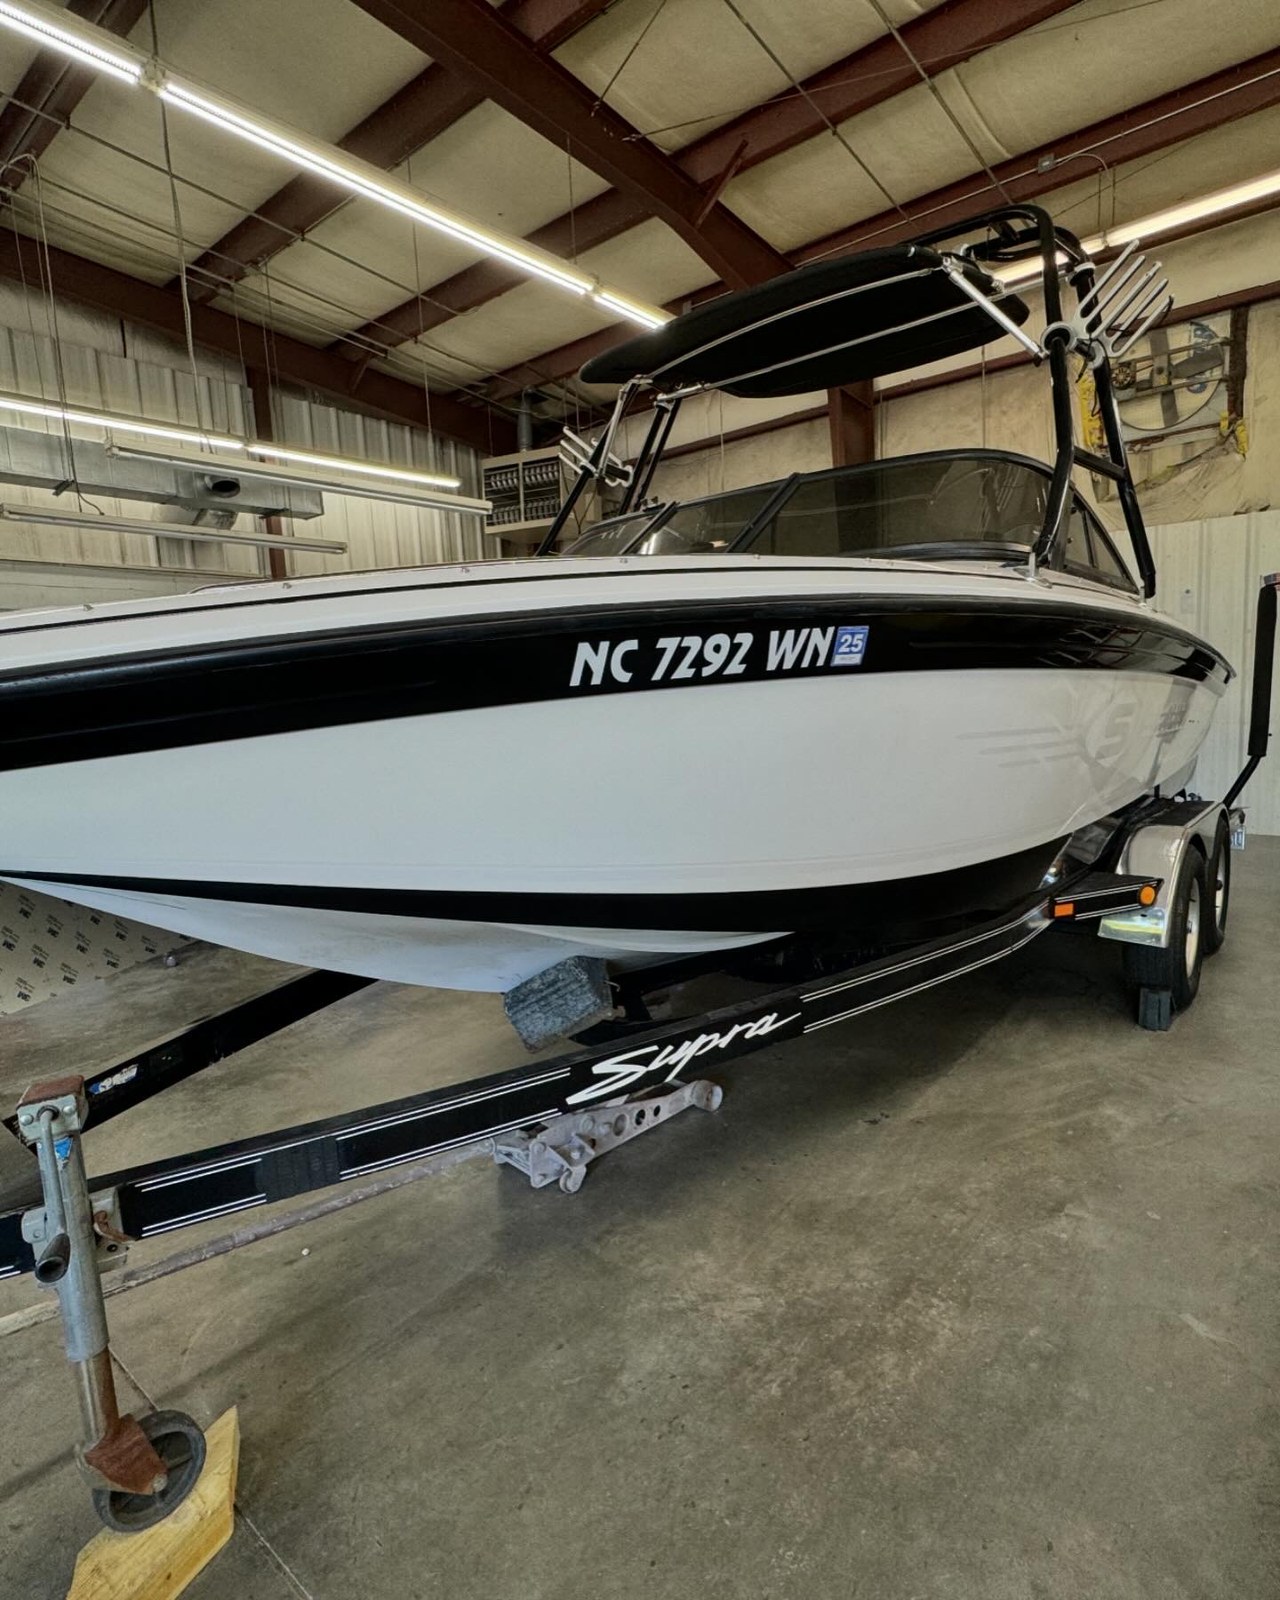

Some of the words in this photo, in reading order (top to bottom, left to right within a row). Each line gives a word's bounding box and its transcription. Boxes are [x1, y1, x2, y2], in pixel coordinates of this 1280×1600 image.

[569, 640, 638, 687] NC
[652, 633, 753, 681] 7292
[766, 626, 836, 671] WN
[838, 633, 865, 653] 25
[565, 1012, 802, 1105] Supra
